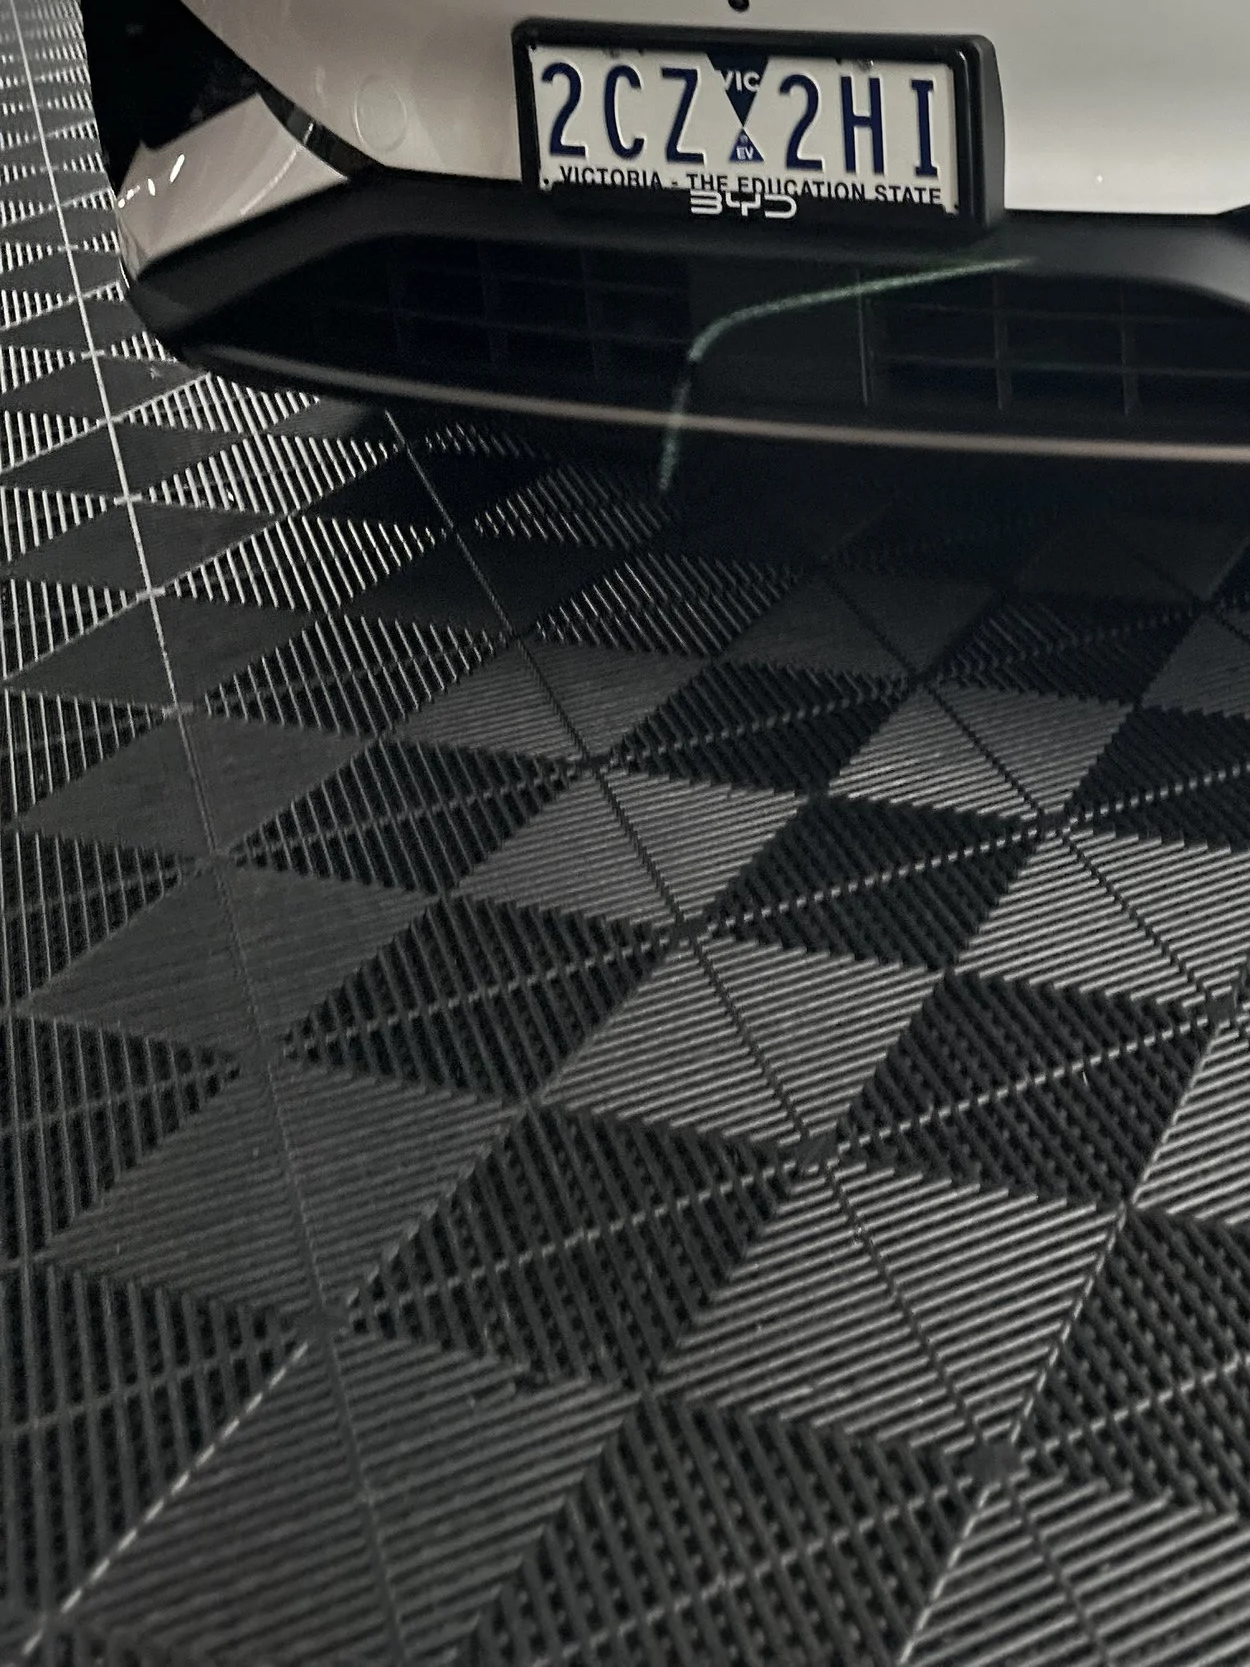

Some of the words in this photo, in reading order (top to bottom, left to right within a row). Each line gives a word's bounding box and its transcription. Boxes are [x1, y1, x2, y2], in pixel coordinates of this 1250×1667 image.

[721, 69, 760, 92] VIC
[736, 145, 754, 160] EV
[560, 166, 663, 189] VICTORIA
[686, 173, 727, 191] THE
[737, 176, 866, 201] EDUCATION
[875, 185, 941, 205] STATE
[690, 189, 797, 219] BYD
